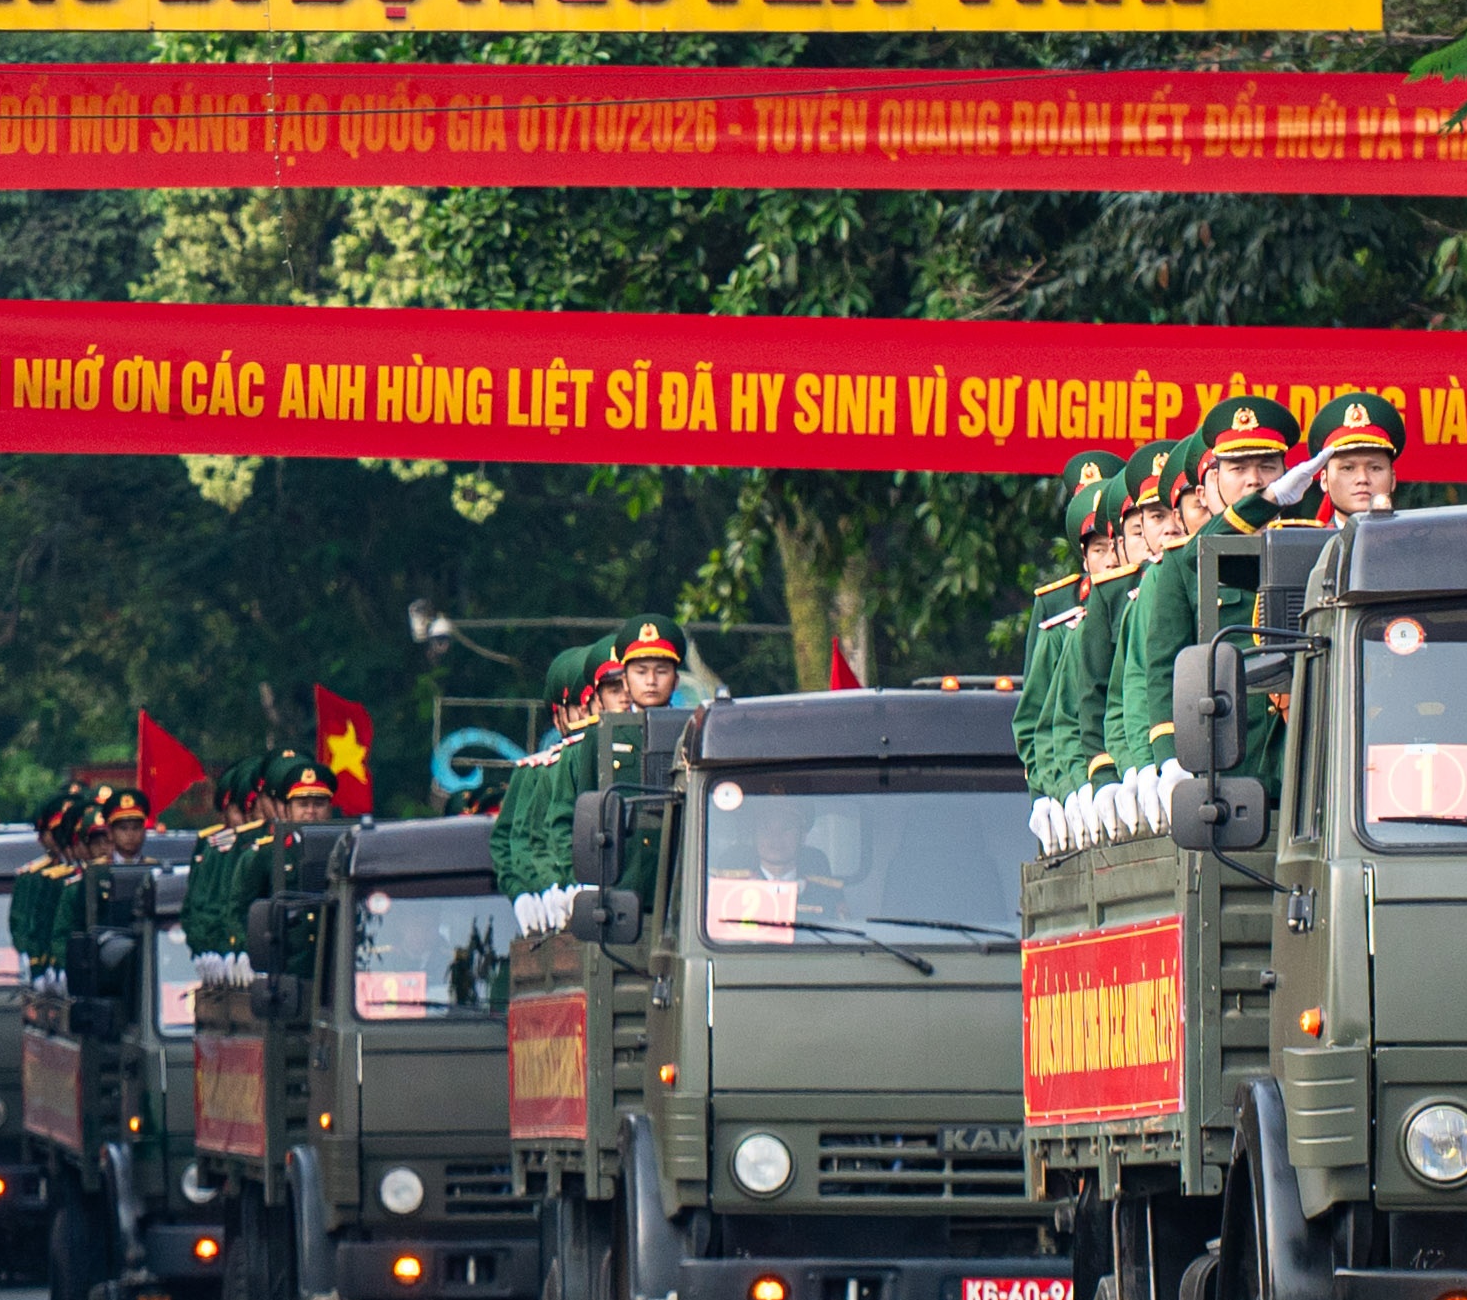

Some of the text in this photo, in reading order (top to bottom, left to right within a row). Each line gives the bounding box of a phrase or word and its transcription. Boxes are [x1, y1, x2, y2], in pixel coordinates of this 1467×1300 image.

[70, 82, 140, 155] MỚI
[150, 81, 250, 154] SÁNG
[260, 94, 328, 167] TẠO
[338, 74, 436, 160] QUỐC
[447, 93, 507, 153] GIA
[752, 85, 869, 154] TUYÊN
[878, 98, 1001, 162] QUANG
[1009, 89, 1111, 157] ĐOÀN
[1202, 80, 1266, 158] ĐỔI
[1275, 92, 1346, 159] MỚI
[1358, 94, 1404, 161] VÀ
[13, 344, 105, 411] NHỚ
[112, 355, 171, 414] ƠN
[181, 349, 266, 418] CÁC
[278, 363, 367, 422] ANH
[376, 353, 493, 426] HÙNG
[507, 356, 594, 436] LIỆT
[605, 359, 653, 431] SĨ
[658, 361, 718, 432] ĐÃ
[730, 372, 786, 433] HY
[793, 372, 897, 436] SINH
[908, 364, 948, 437] VÌ
[958, 374, 1023, 447] SỰ
[1027, 369, 1183, 447] NGHIỆP
[944, 1130, 1025, 1152] KAM
